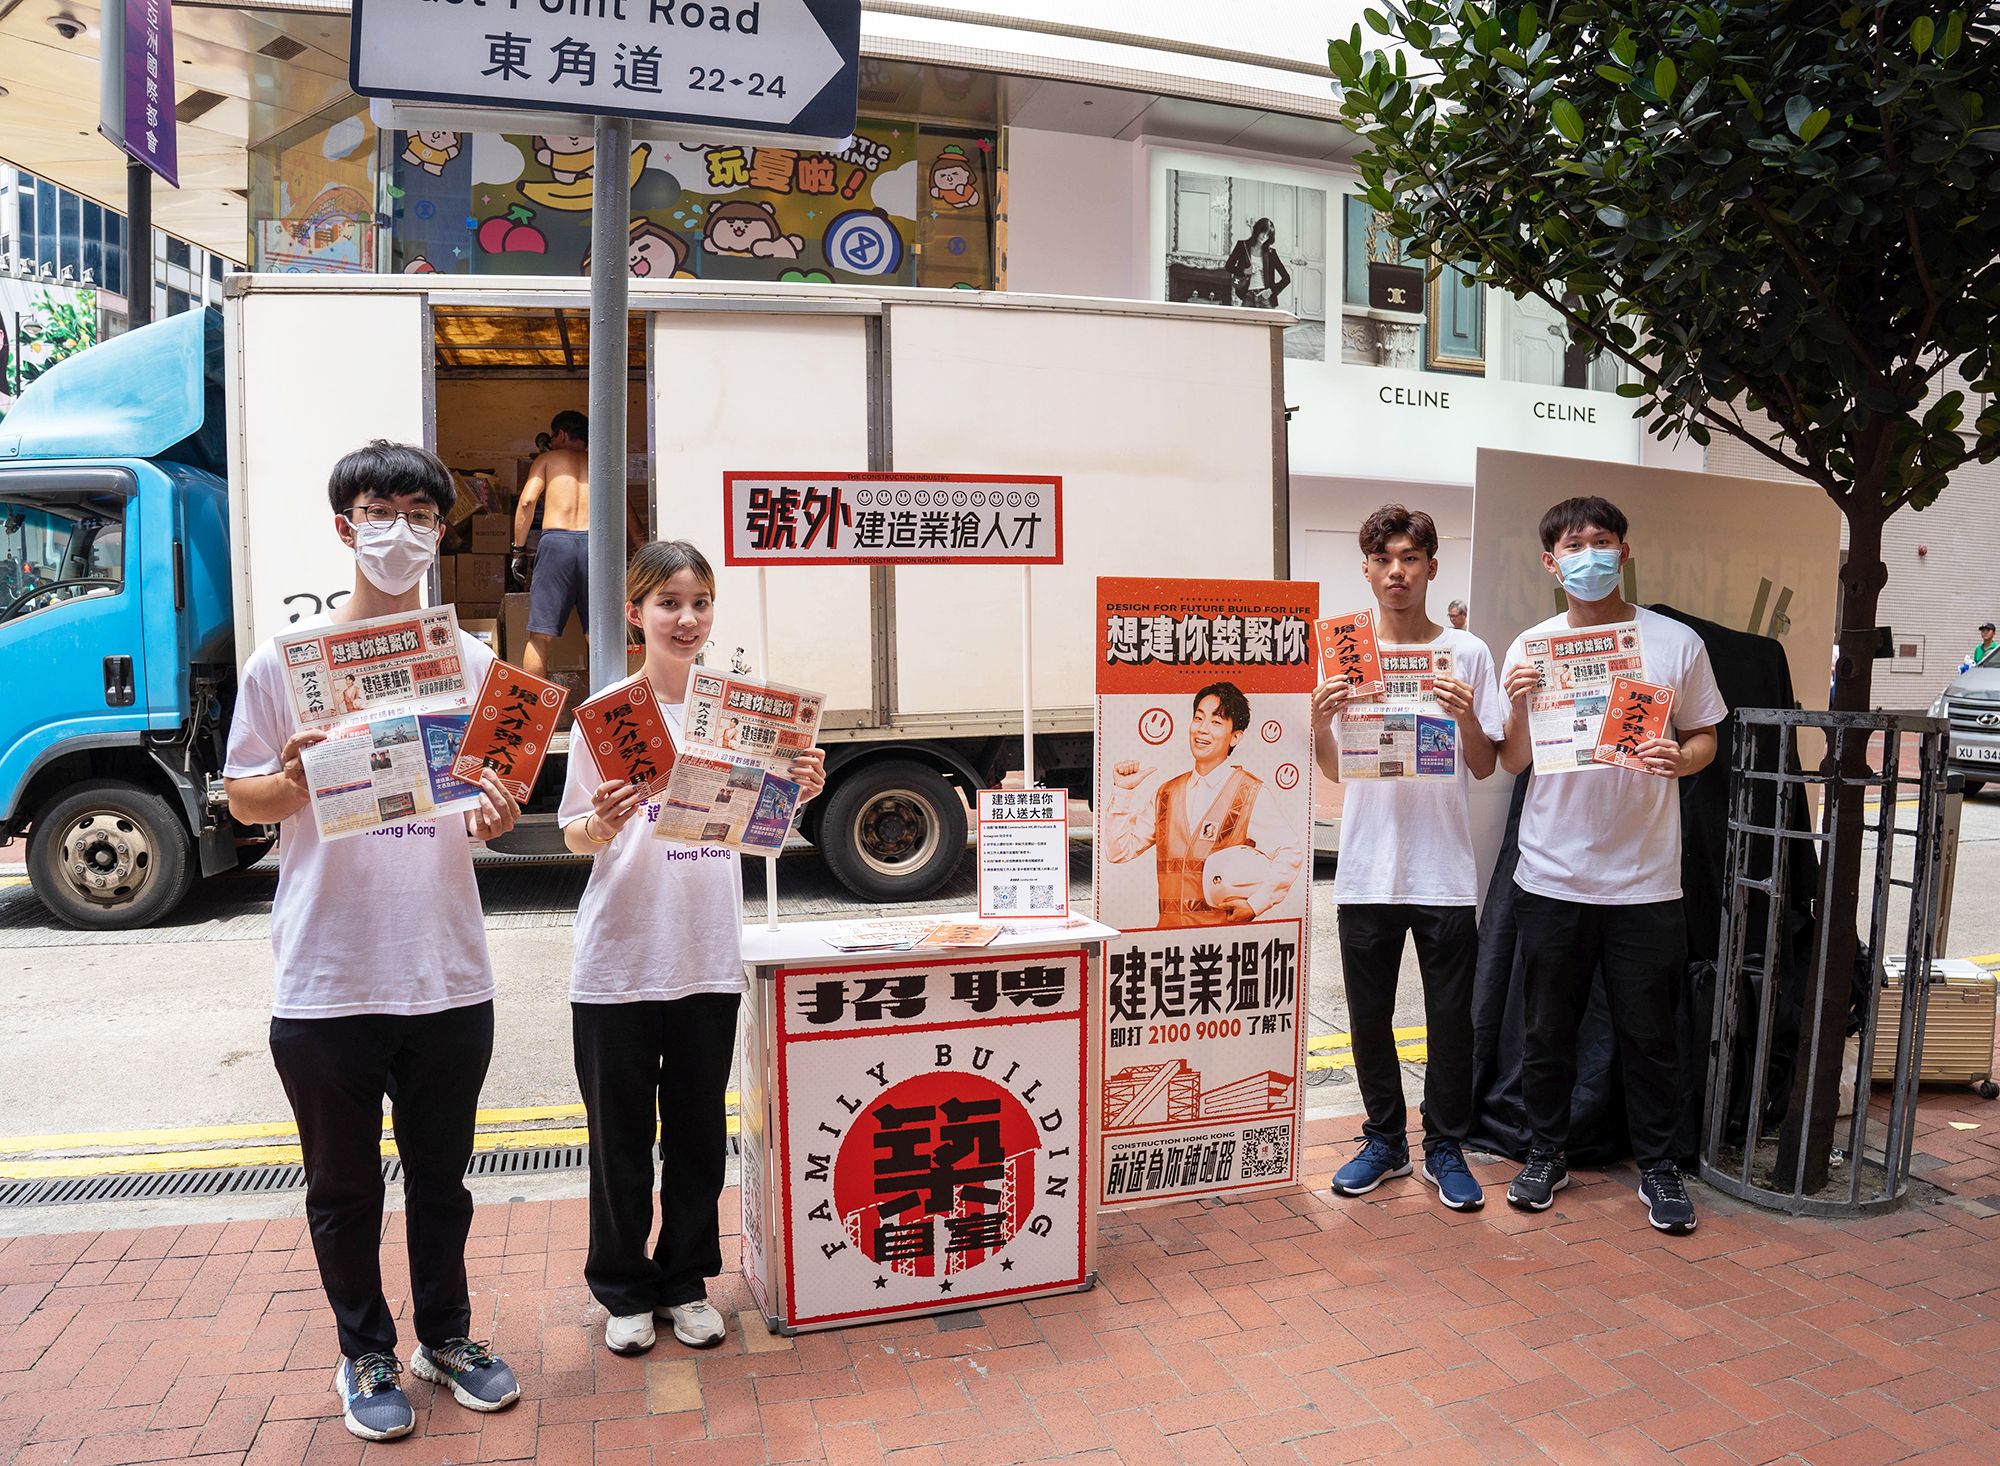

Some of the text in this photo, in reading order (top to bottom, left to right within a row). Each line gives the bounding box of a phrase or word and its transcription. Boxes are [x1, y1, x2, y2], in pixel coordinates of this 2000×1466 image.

[649, 0, 759, 35] Road
[481, 32, 663, 94] 東角道
[1379, 386, 1450, 409] CELINE
[1533, 401, 1597, 424] CELINE
[746, 486, 1042, 550] 號外 建造業搶人才
[1106, 603, 1150, 611] DESIGN
[1180, 604, 1225, 613] FUTURE
[1228, 605, 1261, 613] BUILD
[1289, 606, 1311, 614] LIFE
[1106, 614, 1310, 666] 想建你築緊你
[482, 685, 539, 775] 搵人才發大財
[1959, 747, 2000, 760] XU 134
[991, 793, 1054, 806] 建造業搵你
[991, 807, 1054, 820] 招人送大禮
[366, 824, 436, 838] ong Kong
[667, 847, 731, 861] Hong Kong
[796, 964, 1067, 1025] 招聘
[1109, 938, 1296, 1023] 建造業搵你
[1110, 1012, 1292, 1048] 即打 2100 9000 了解下
[805, 1062, 890, 1259] FAMILY
[934, 1043, 1069, 1239] BUILDING
[1111, 1131, 1236, 1151] CONSTRUCTION HONG KONG
